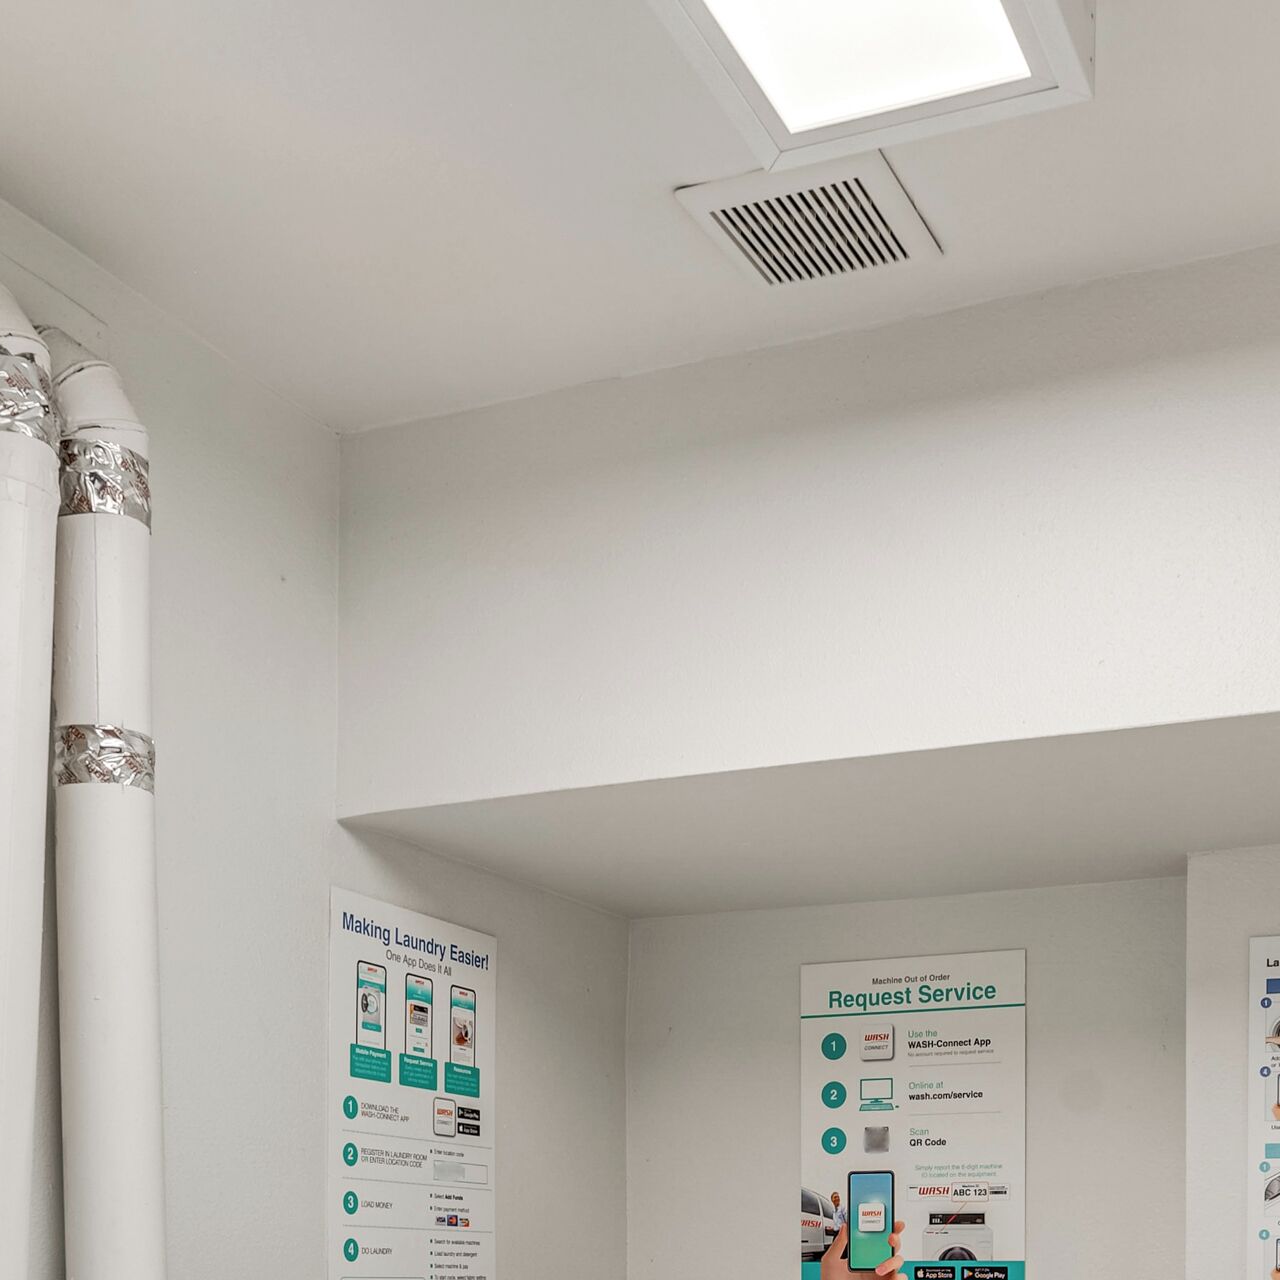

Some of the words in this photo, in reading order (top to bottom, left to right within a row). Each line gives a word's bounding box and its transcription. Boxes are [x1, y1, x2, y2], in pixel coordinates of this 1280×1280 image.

[342, 912, 390, 946] Making
[395, 927, 446, 961] Laundry
[450, 944, 489, 970] Easier!
[386, 950, 401, 963] One
[403, 954, 416, 968] App
[418, 958, 436, 972] Does
[438, 965, 442, 974] It
[443, 966, 452, 976] All
[872, 977, 903, 985] Machine
[904, 975, 918, 983] Out
[920, 975, 928, 983] of
[929, 974, 950, 982] Order
[828, 987, 912, 1011] Request
[918, 982, 997, 1004] Service
[864, 1033, 889, 1042] WASH
[908, 1030, 923, 1039] Use
[925, 1029, 938, 1037] the
[830, 1040, 836, 1051] 1
[908, 1039, 972, 1049] WASH-Connect
[974, 1038, 991, 1047] App
[909, 1082, 934, 1090] Online
[936, 1081, 944, 1089] at
[830, 1090, 837, 1100] 2
[909, 1090, 983, 1101] wash.com/service
[348, 1100, 353, 1113] 1
[361, 1102, 389, 1112] DOWNLOAD
[390, 1106, 399, 1114] THE
[909, 1128, 929, 1136] Scan
[830, 1137, 837, 1147] 3
[909, 1138, 923, 1147] QR
[925, 1138, 947, 1146] Code
[347, 1147, 354, 1160] 2
[361, 1148, 384, 1157] REGISTER
[390, 1151, 412, 1159] LAUNDRY
[370, 1156, 385, 1165] ENTER
[386, 1158, 409, 1167] LOCATION
[409, 1160, 423, 1168] CODE
[918, 1186, 950, 1195] WASH
[348, 1195, 354, 1208] 3
[375, 1201, 392, 1209] MONEY
[349, 1243, 354, 1255] 4
[974, 1272, 993, 1280] Google
[994, 1272, 1005, 1280] Play
